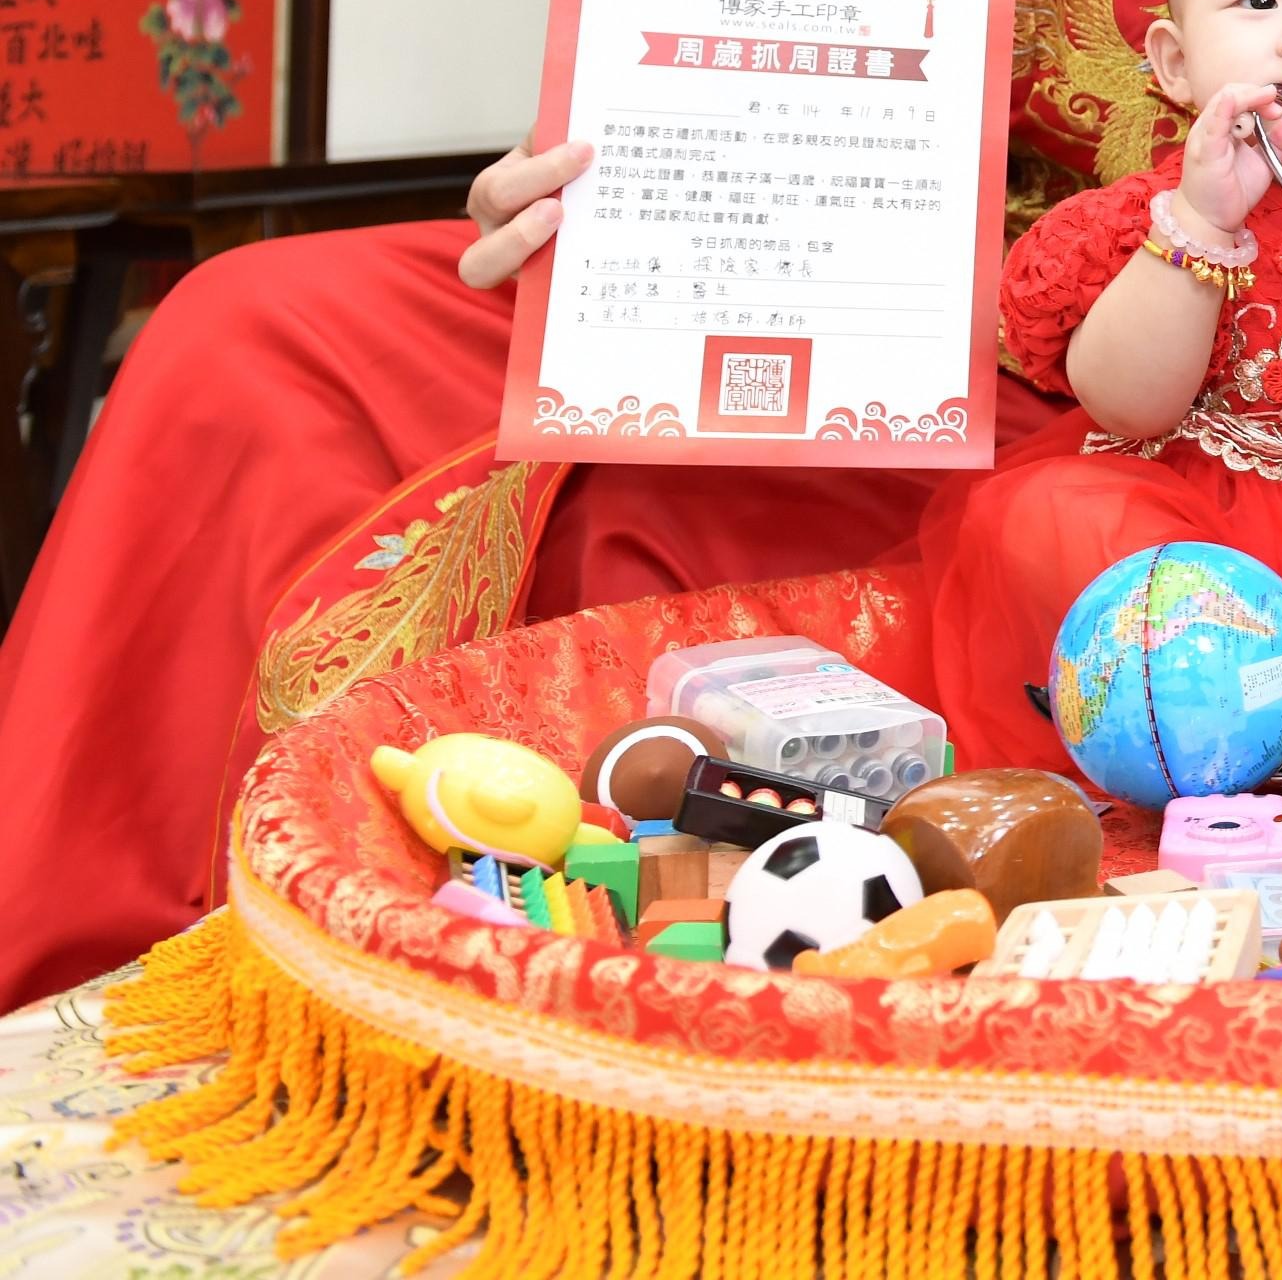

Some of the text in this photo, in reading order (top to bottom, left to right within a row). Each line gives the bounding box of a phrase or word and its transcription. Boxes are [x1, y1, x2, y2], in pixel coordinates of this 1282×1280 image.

[720, 18, 856, 34] www.seals.com.tw
[673, 37, 895, 78] 周歲抓周證書
[840, 105, 853, 117] 年
[883, 107, 895, 120] 月
[925, 110, 935, 122] 日
